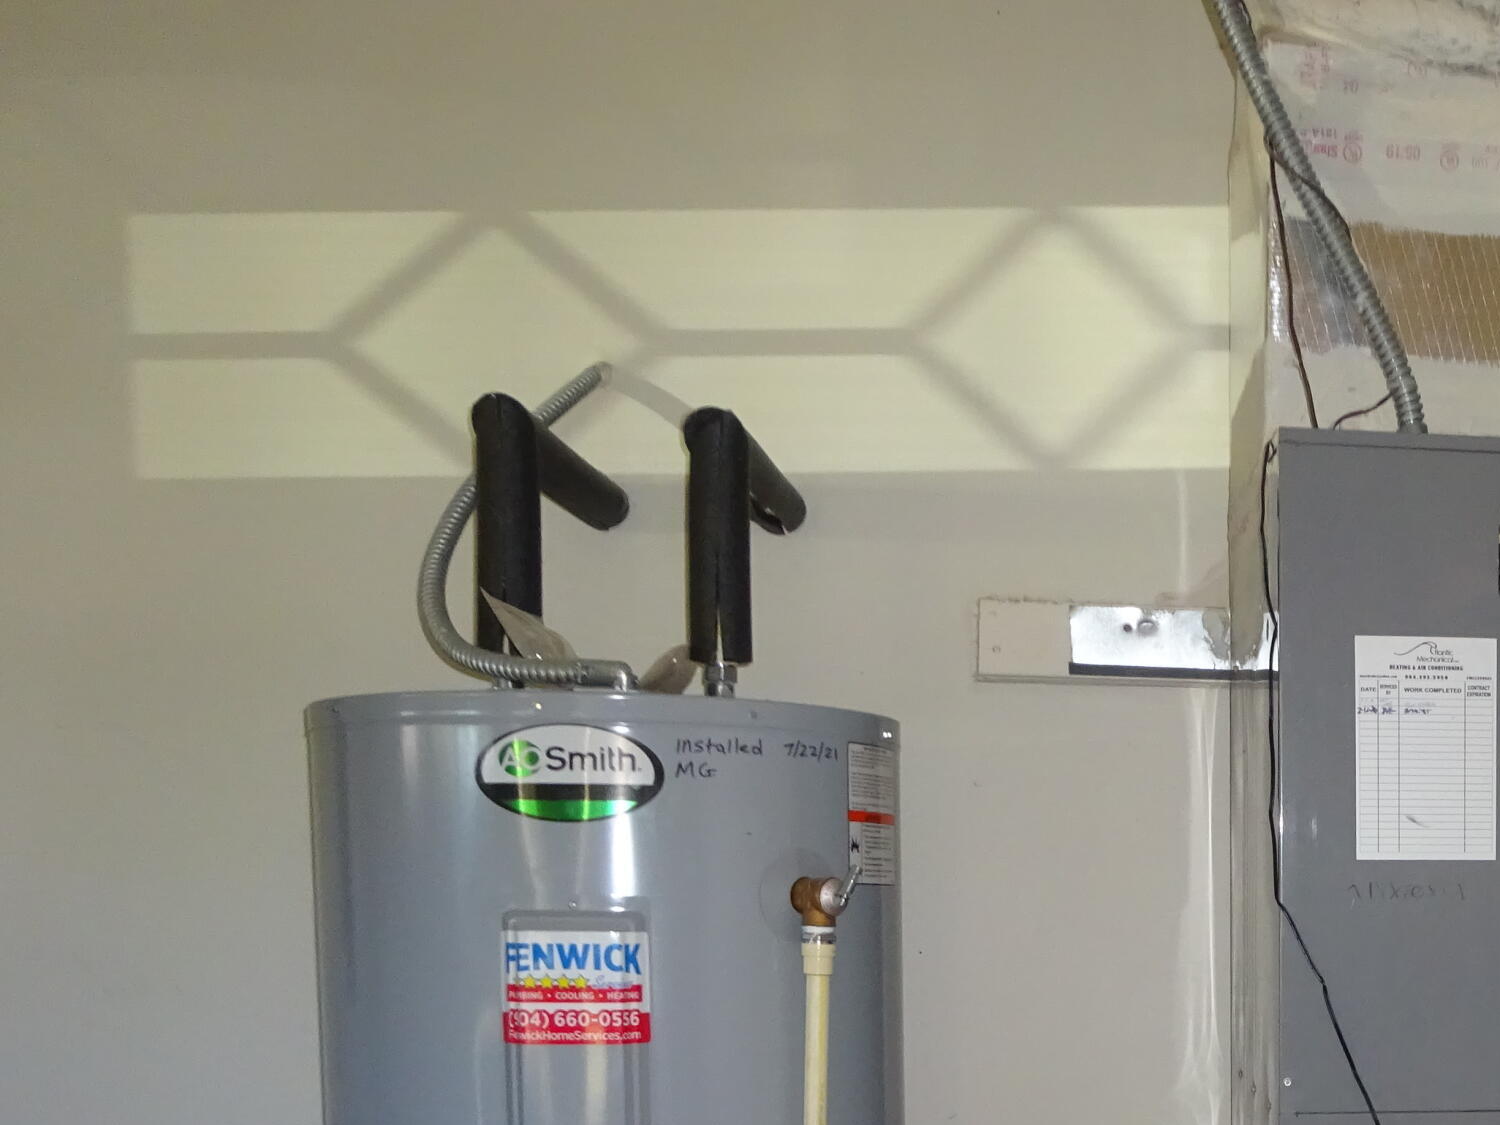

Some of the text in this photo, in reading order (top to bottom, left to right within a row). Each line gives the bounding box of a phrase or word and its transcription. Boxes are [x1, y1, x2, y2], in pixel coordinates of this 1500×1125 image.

[676, 738, 763, 756] Installed
[545, 746, 637, 772] Smith
[505, 942, 642, 974] FENWICK
[555, 991, 595, 1000] COOLING
[606, 991, 640, 1000] HEATING
[554, 1011, 640, 1028] 660-0556
